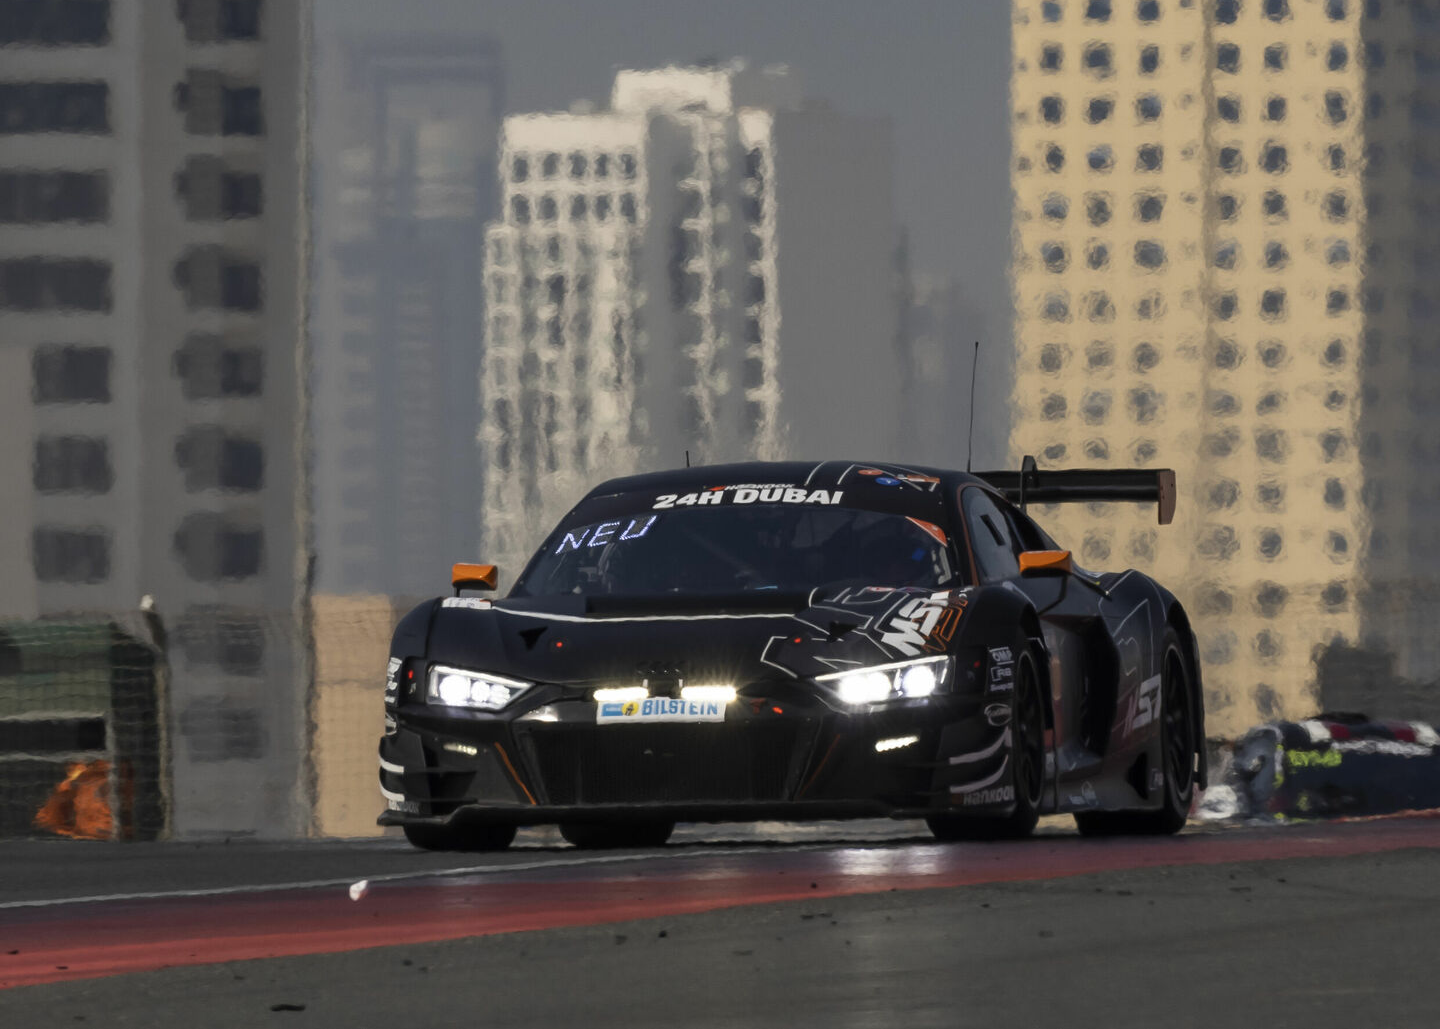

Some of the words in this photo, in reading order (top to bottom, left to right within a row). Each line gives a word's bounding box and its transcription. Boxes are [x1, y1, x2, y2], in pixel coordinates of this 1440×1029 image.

[652, 490, 724, 510] 24H
[732, 487, 844, 505] DUBAI
[555, 514, 658, 556] NEU
[642, 699, 718, 716] BILSTEIN
